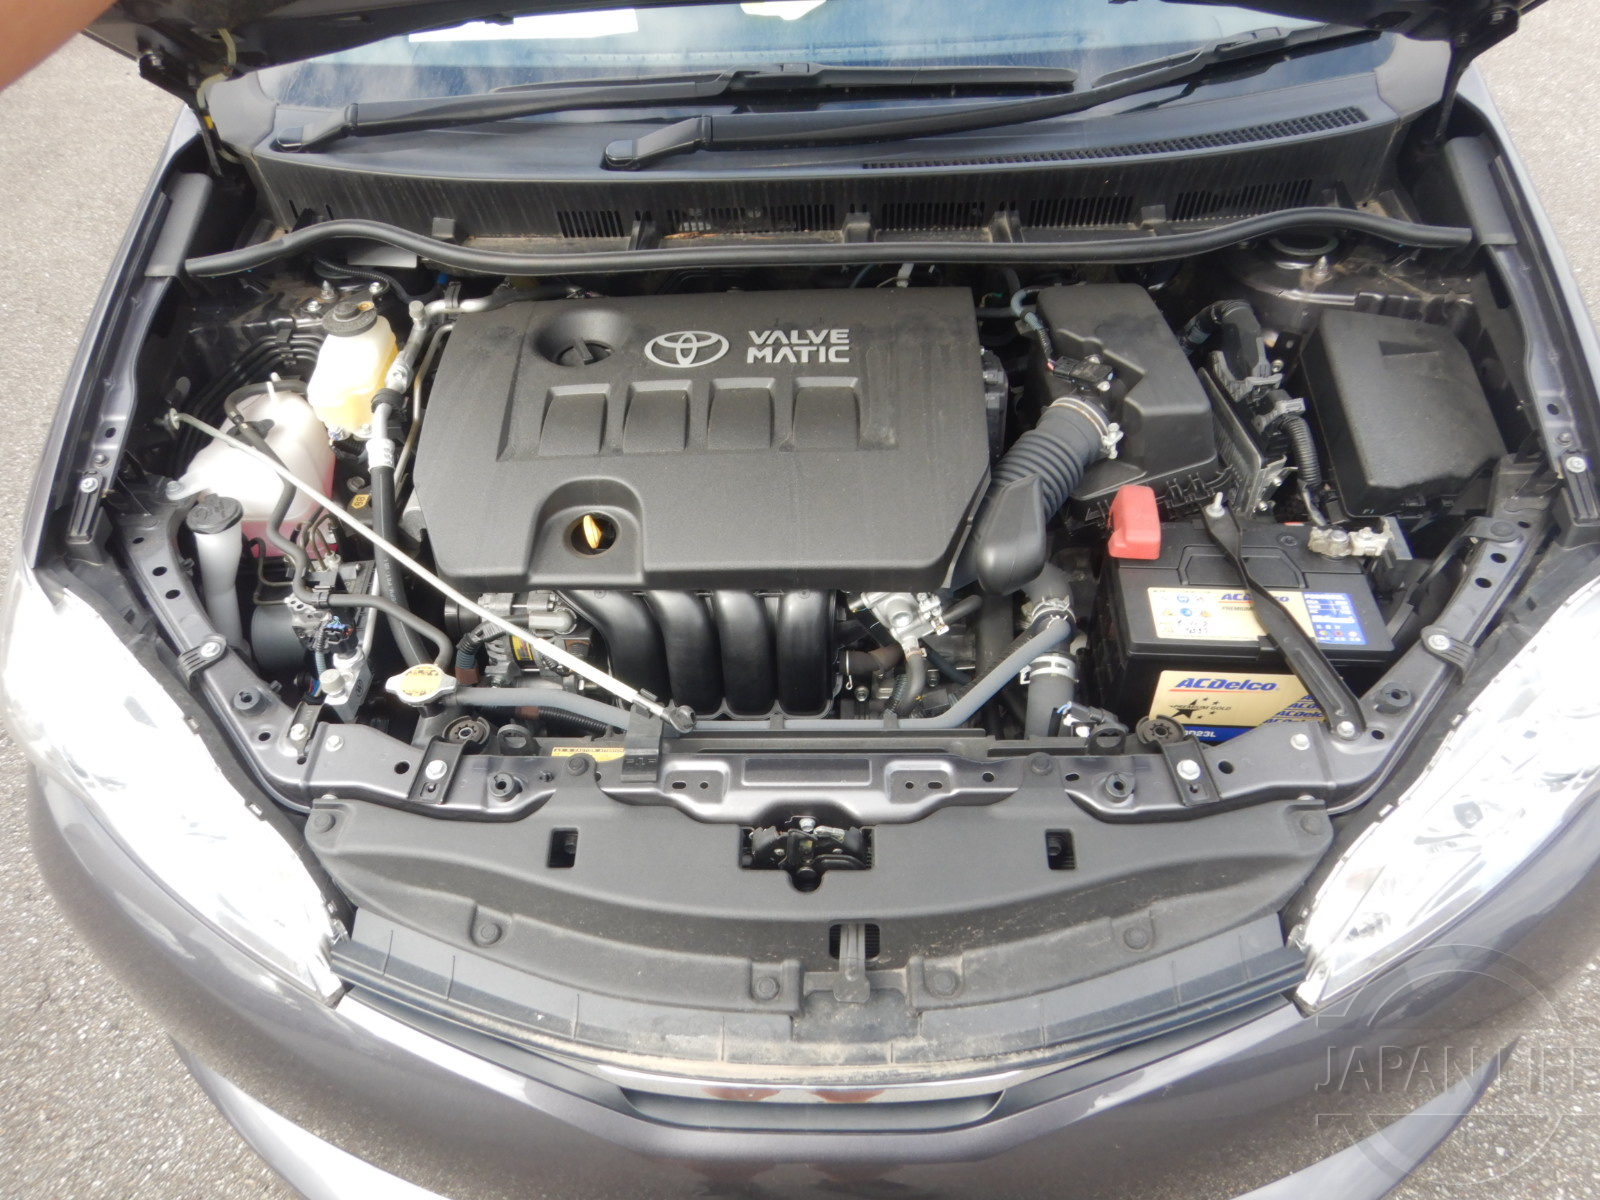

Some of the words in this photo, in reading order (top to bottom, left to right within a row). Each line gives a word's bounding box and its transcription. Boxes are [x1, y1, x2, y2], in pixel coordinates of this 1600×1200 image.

[748, 329, 850, 344] VALVE
[746, 345, 850, 364] MATIC
[1175, 678, 1277, 691] ACDelco
